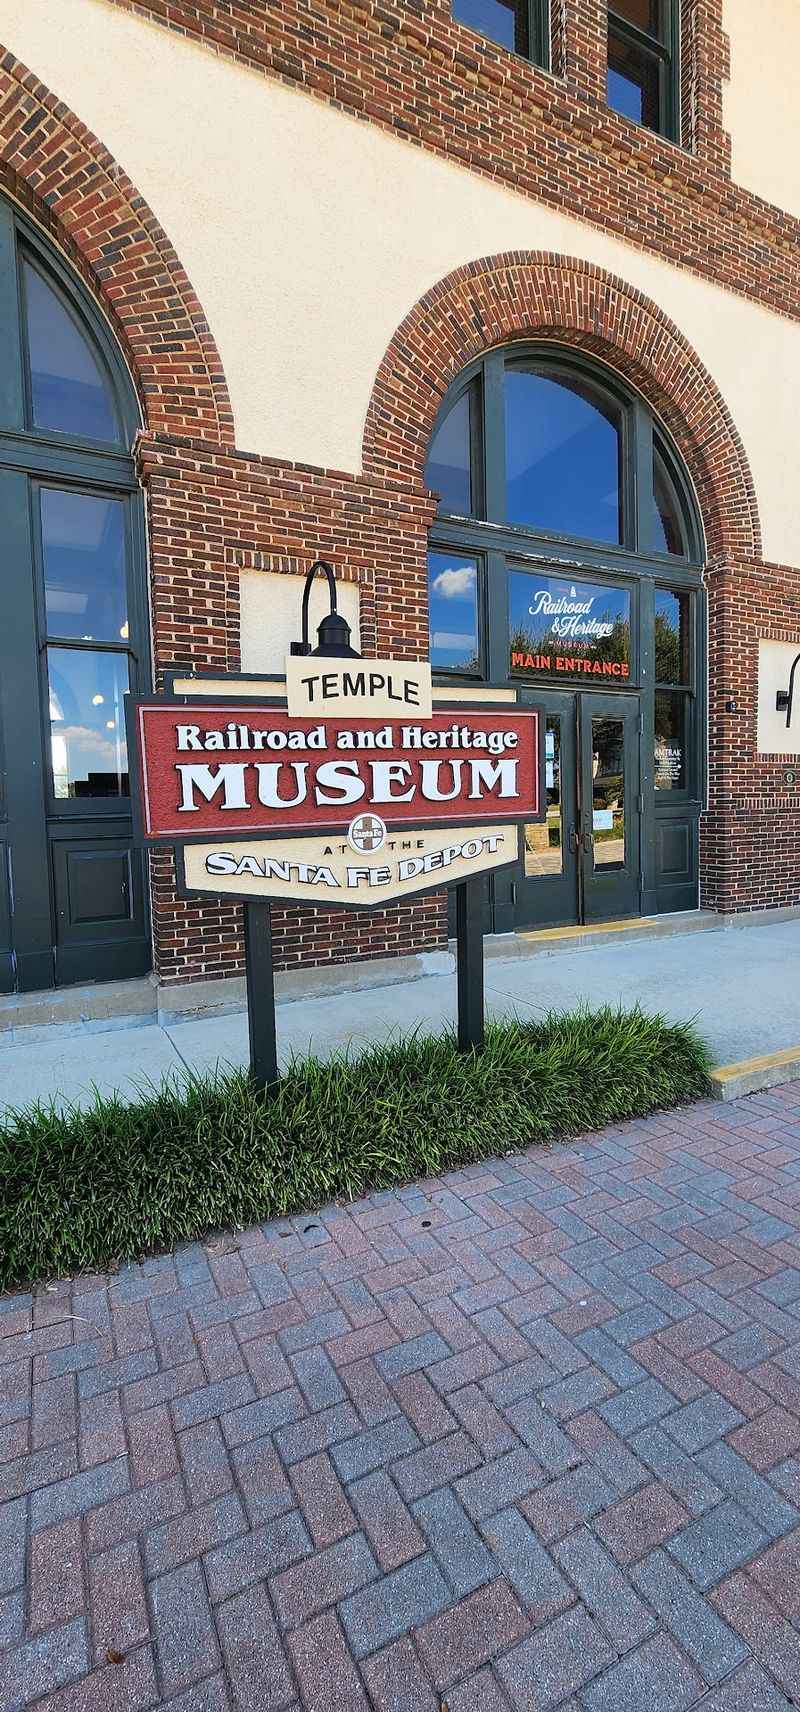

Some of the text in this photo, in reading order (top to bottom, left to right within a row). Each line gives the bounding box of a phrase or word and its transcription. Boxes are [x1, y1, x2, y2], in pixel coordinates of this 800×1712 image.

[528, 590, 594, 615] Railroad
[512, 652, 630, 676] MAIN ENTRANCE
[301, 672, 420, 706] TEMPLE
[175, 722, 519, 755] Railroad and Heritage
[654, 748, 682, 757] AMTRAK
[175, 758, 520, 812] MUSEUM
[353, 829, 382, 839] Santa Fe
[323, 840, 425, 856] AT THE
[204, 834, 504, 888] SANTA FE DEPOT
